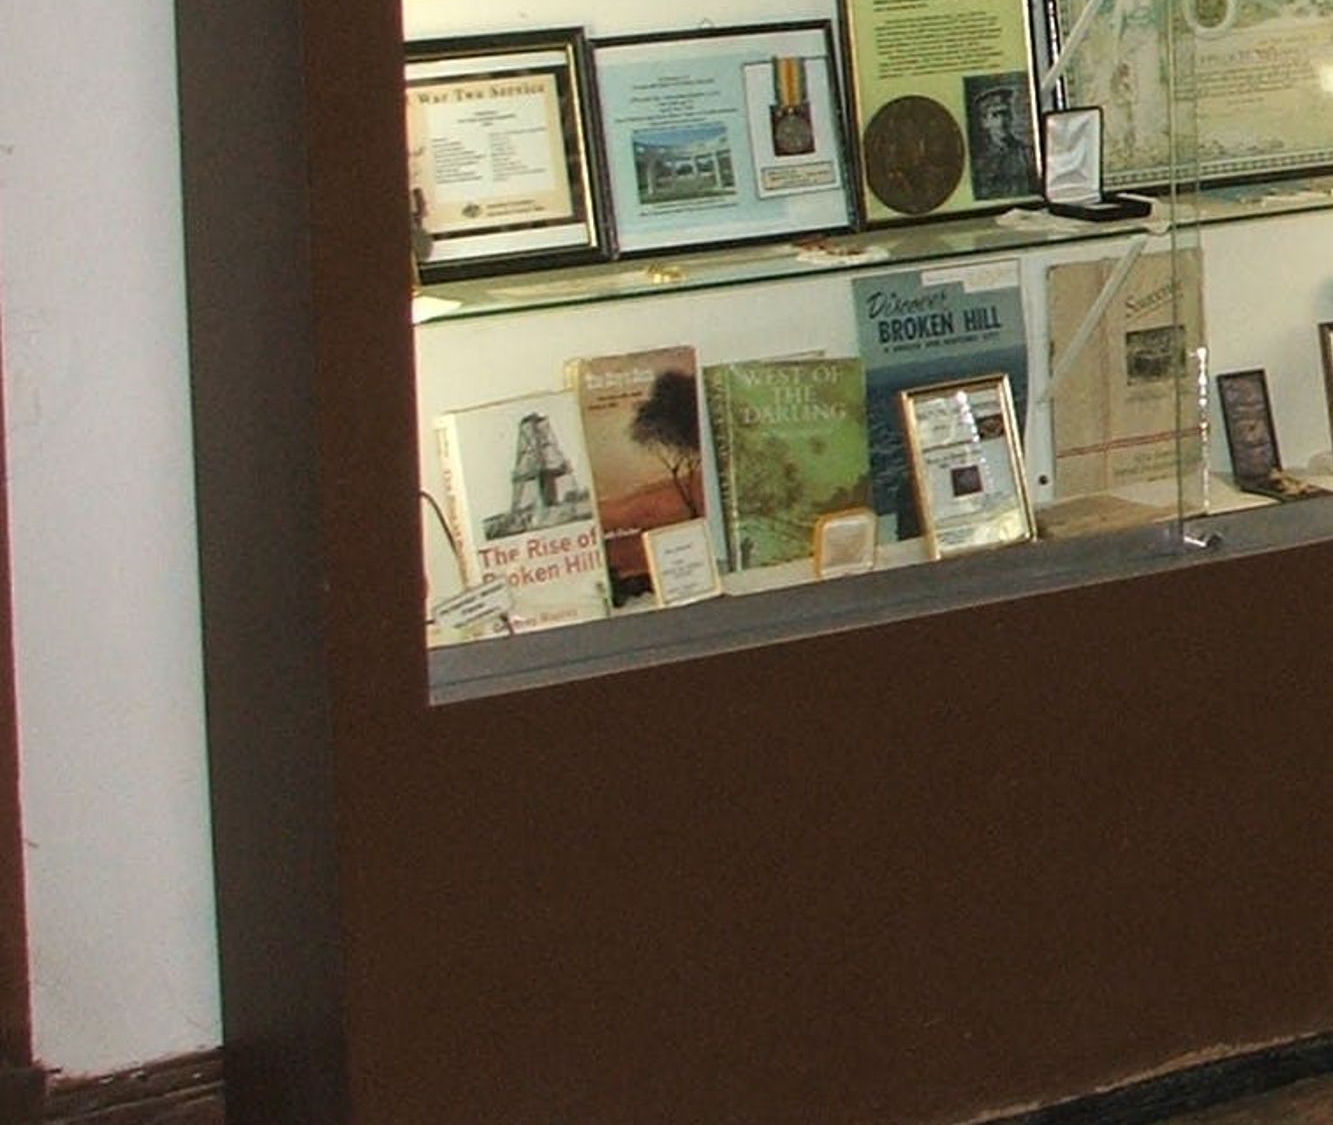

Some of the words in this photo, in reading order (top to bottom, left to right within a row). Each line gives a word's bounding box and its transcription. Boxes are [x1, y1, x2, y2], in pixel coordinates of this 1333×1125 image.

[878, 313, 953, 343] BROKEN
[965, 306, 1002, 332] HILL
[744, 401, 847, 424] DARLING
[479, 545, 519, 570] The
[527, 536, 571, 560] Rise
[577, 527, 598, 548] of
[564, 551, 601, 576] Hill
